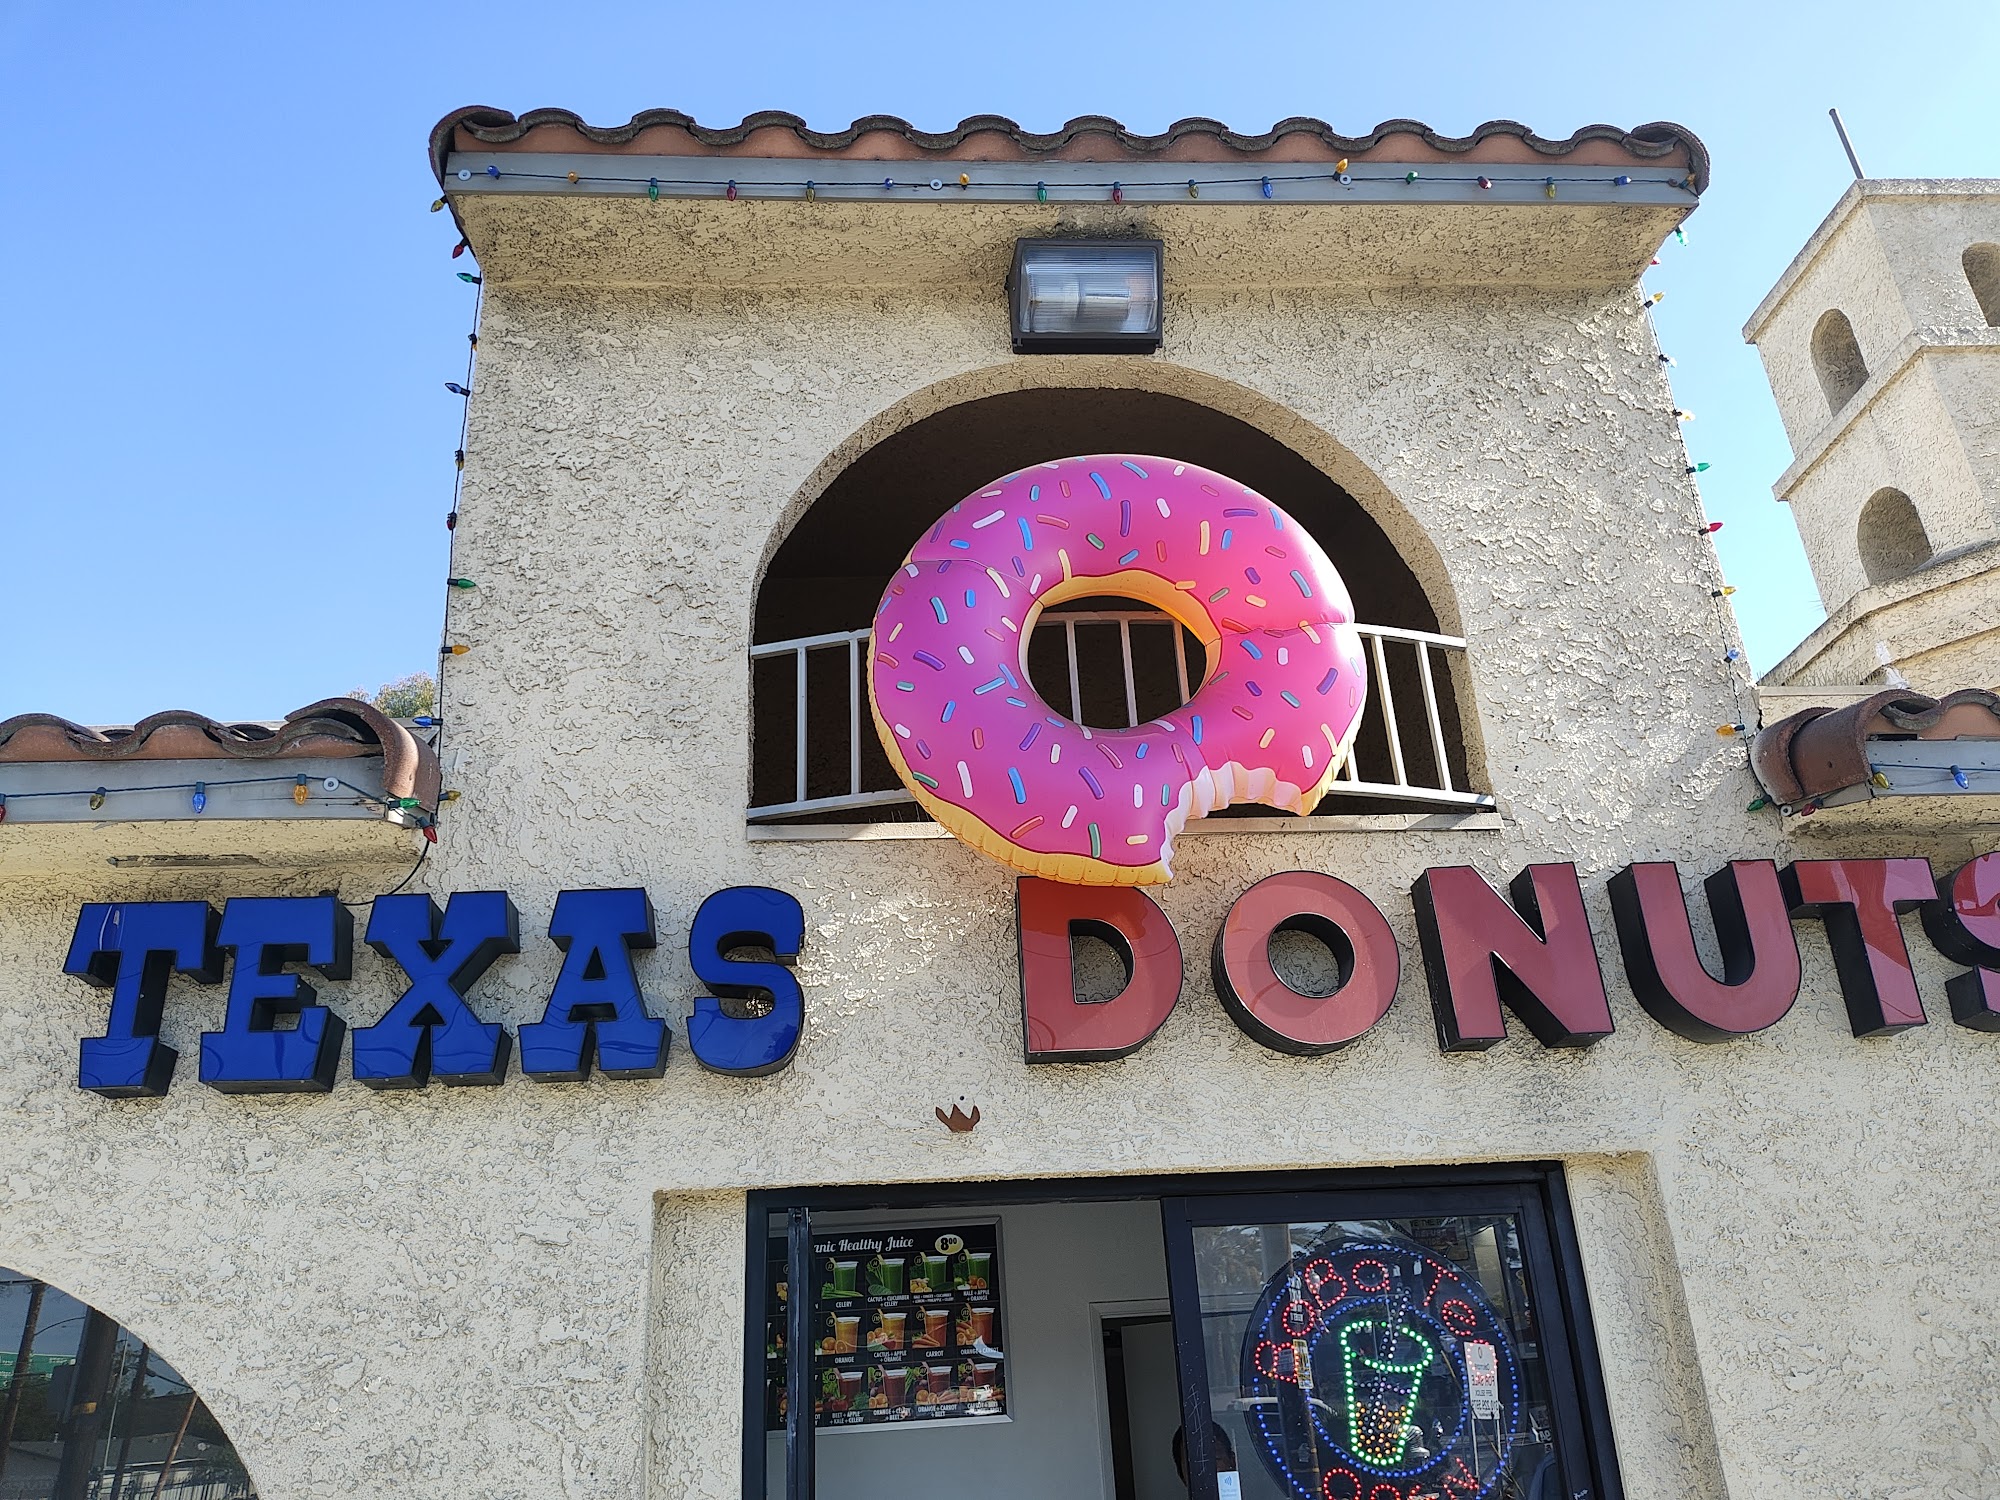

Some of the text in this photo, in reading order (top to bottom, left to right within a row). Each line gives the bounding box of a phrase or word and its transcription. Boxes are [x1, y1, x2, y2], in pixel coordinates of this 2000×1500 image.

[63, 885, 805, 1098] TEXAS
[838, 1238, 882, 1253] Healthy
[885, 1236, 914, 1252] Juice
